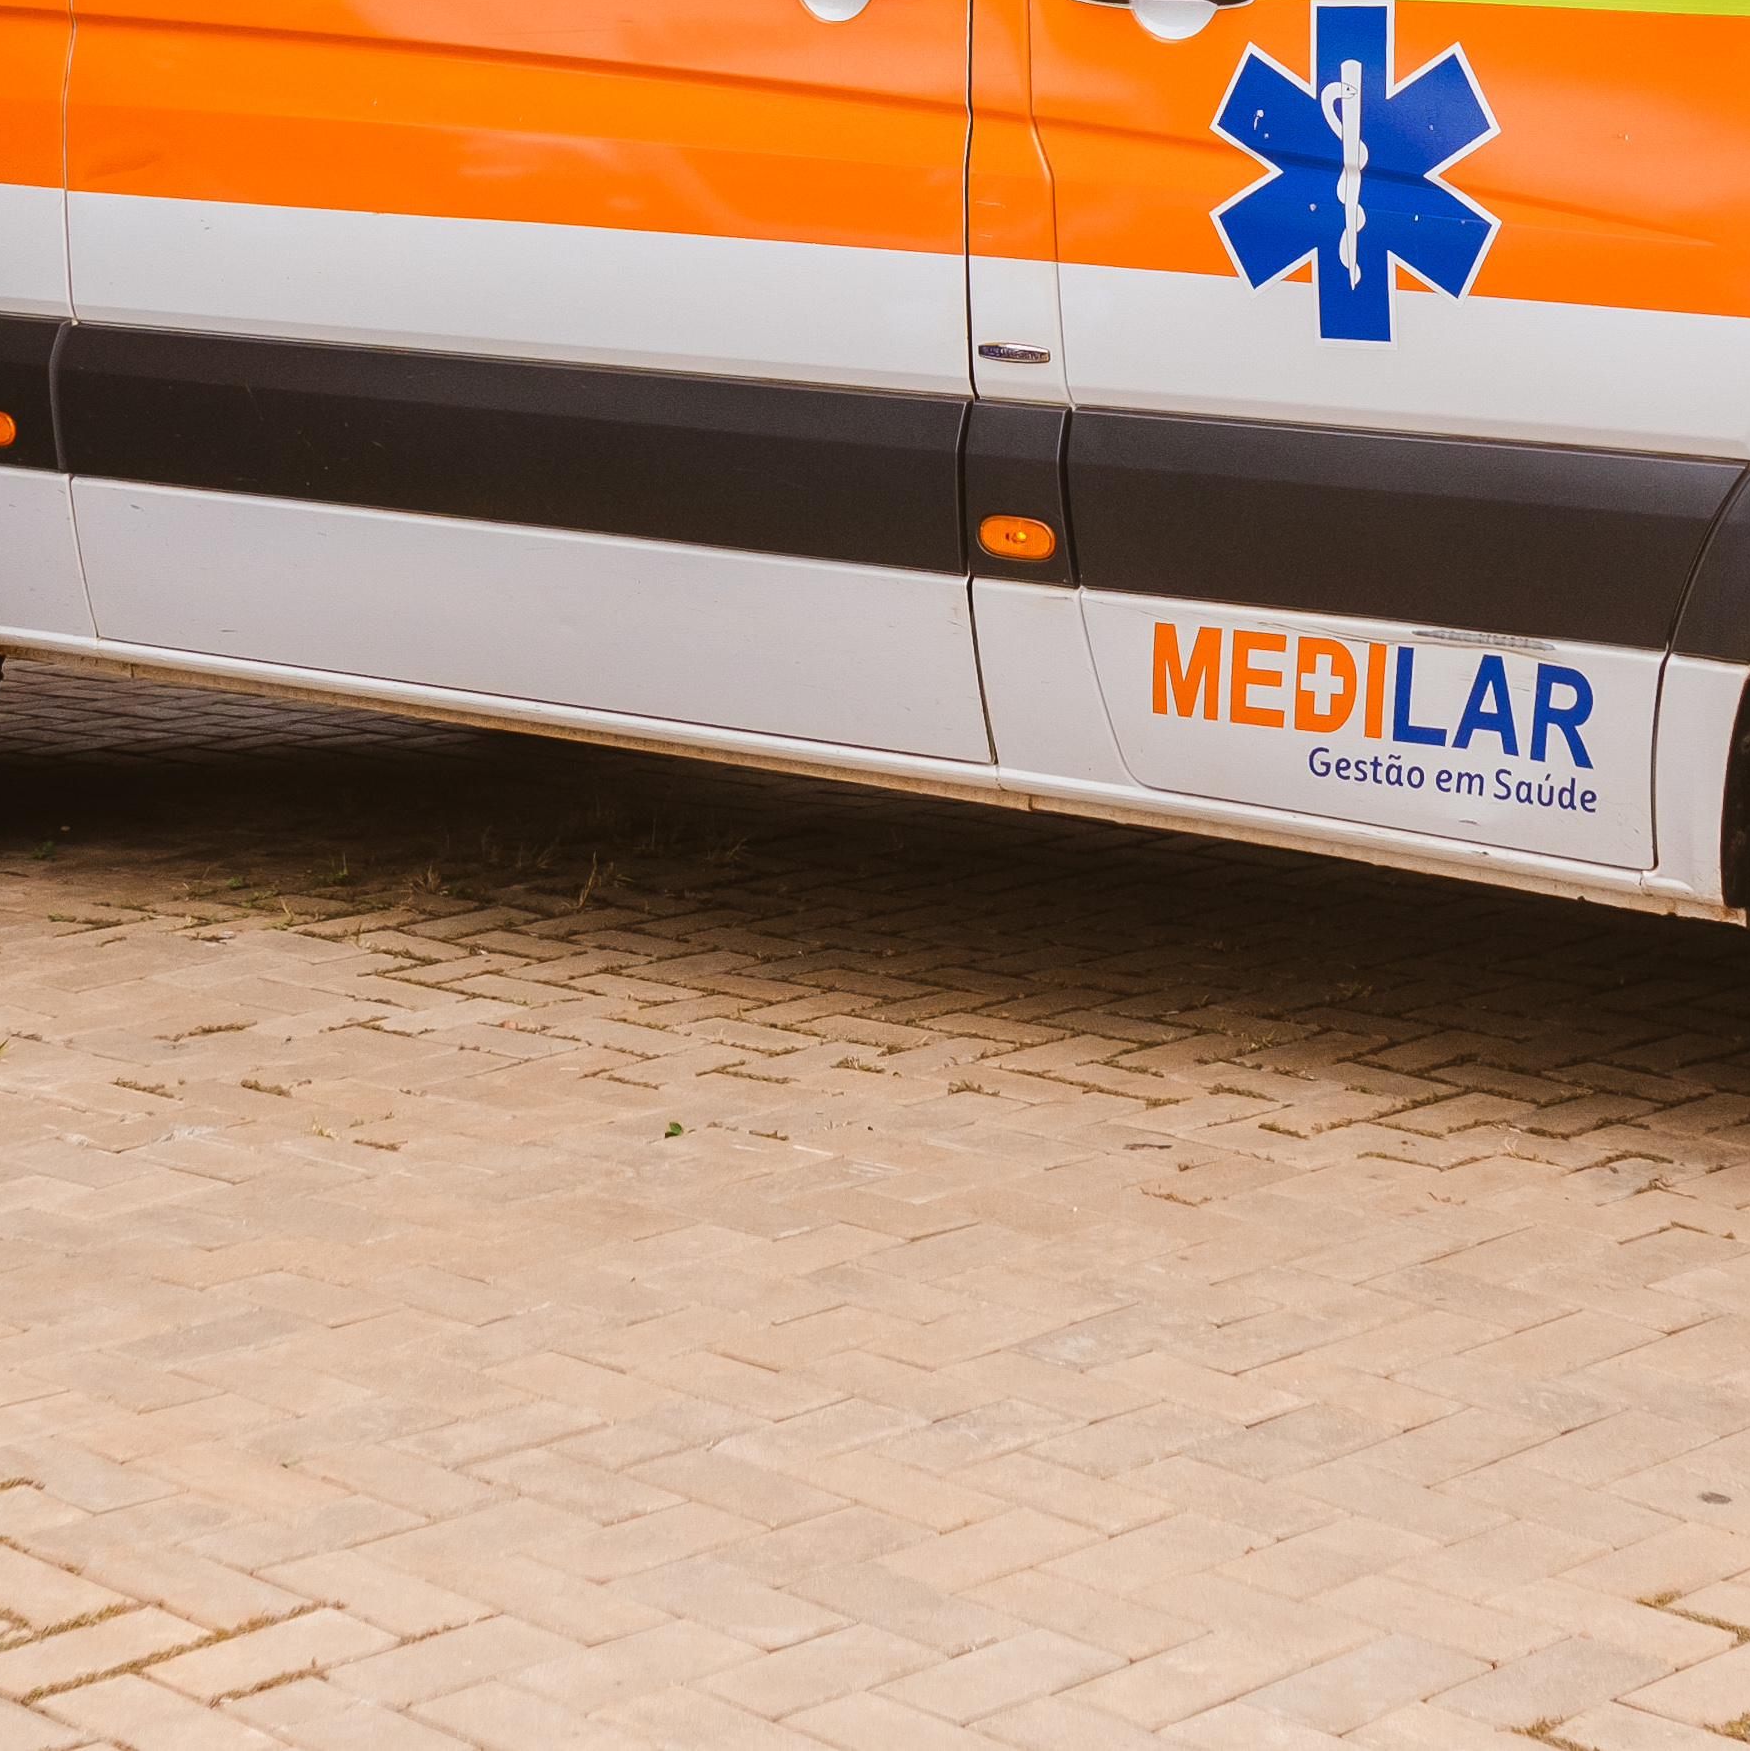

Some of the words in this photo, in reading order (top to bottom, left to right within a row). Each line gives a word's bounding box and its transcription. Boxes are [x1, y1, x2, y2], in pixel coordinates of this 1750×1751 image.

[1152, 622, 1595, 770] MEDILAR
[1308, 747, 1425, 789] Gestão
[1435, 768, 1485, 796] em
[1493, 768, 1598, 813] Saúde
